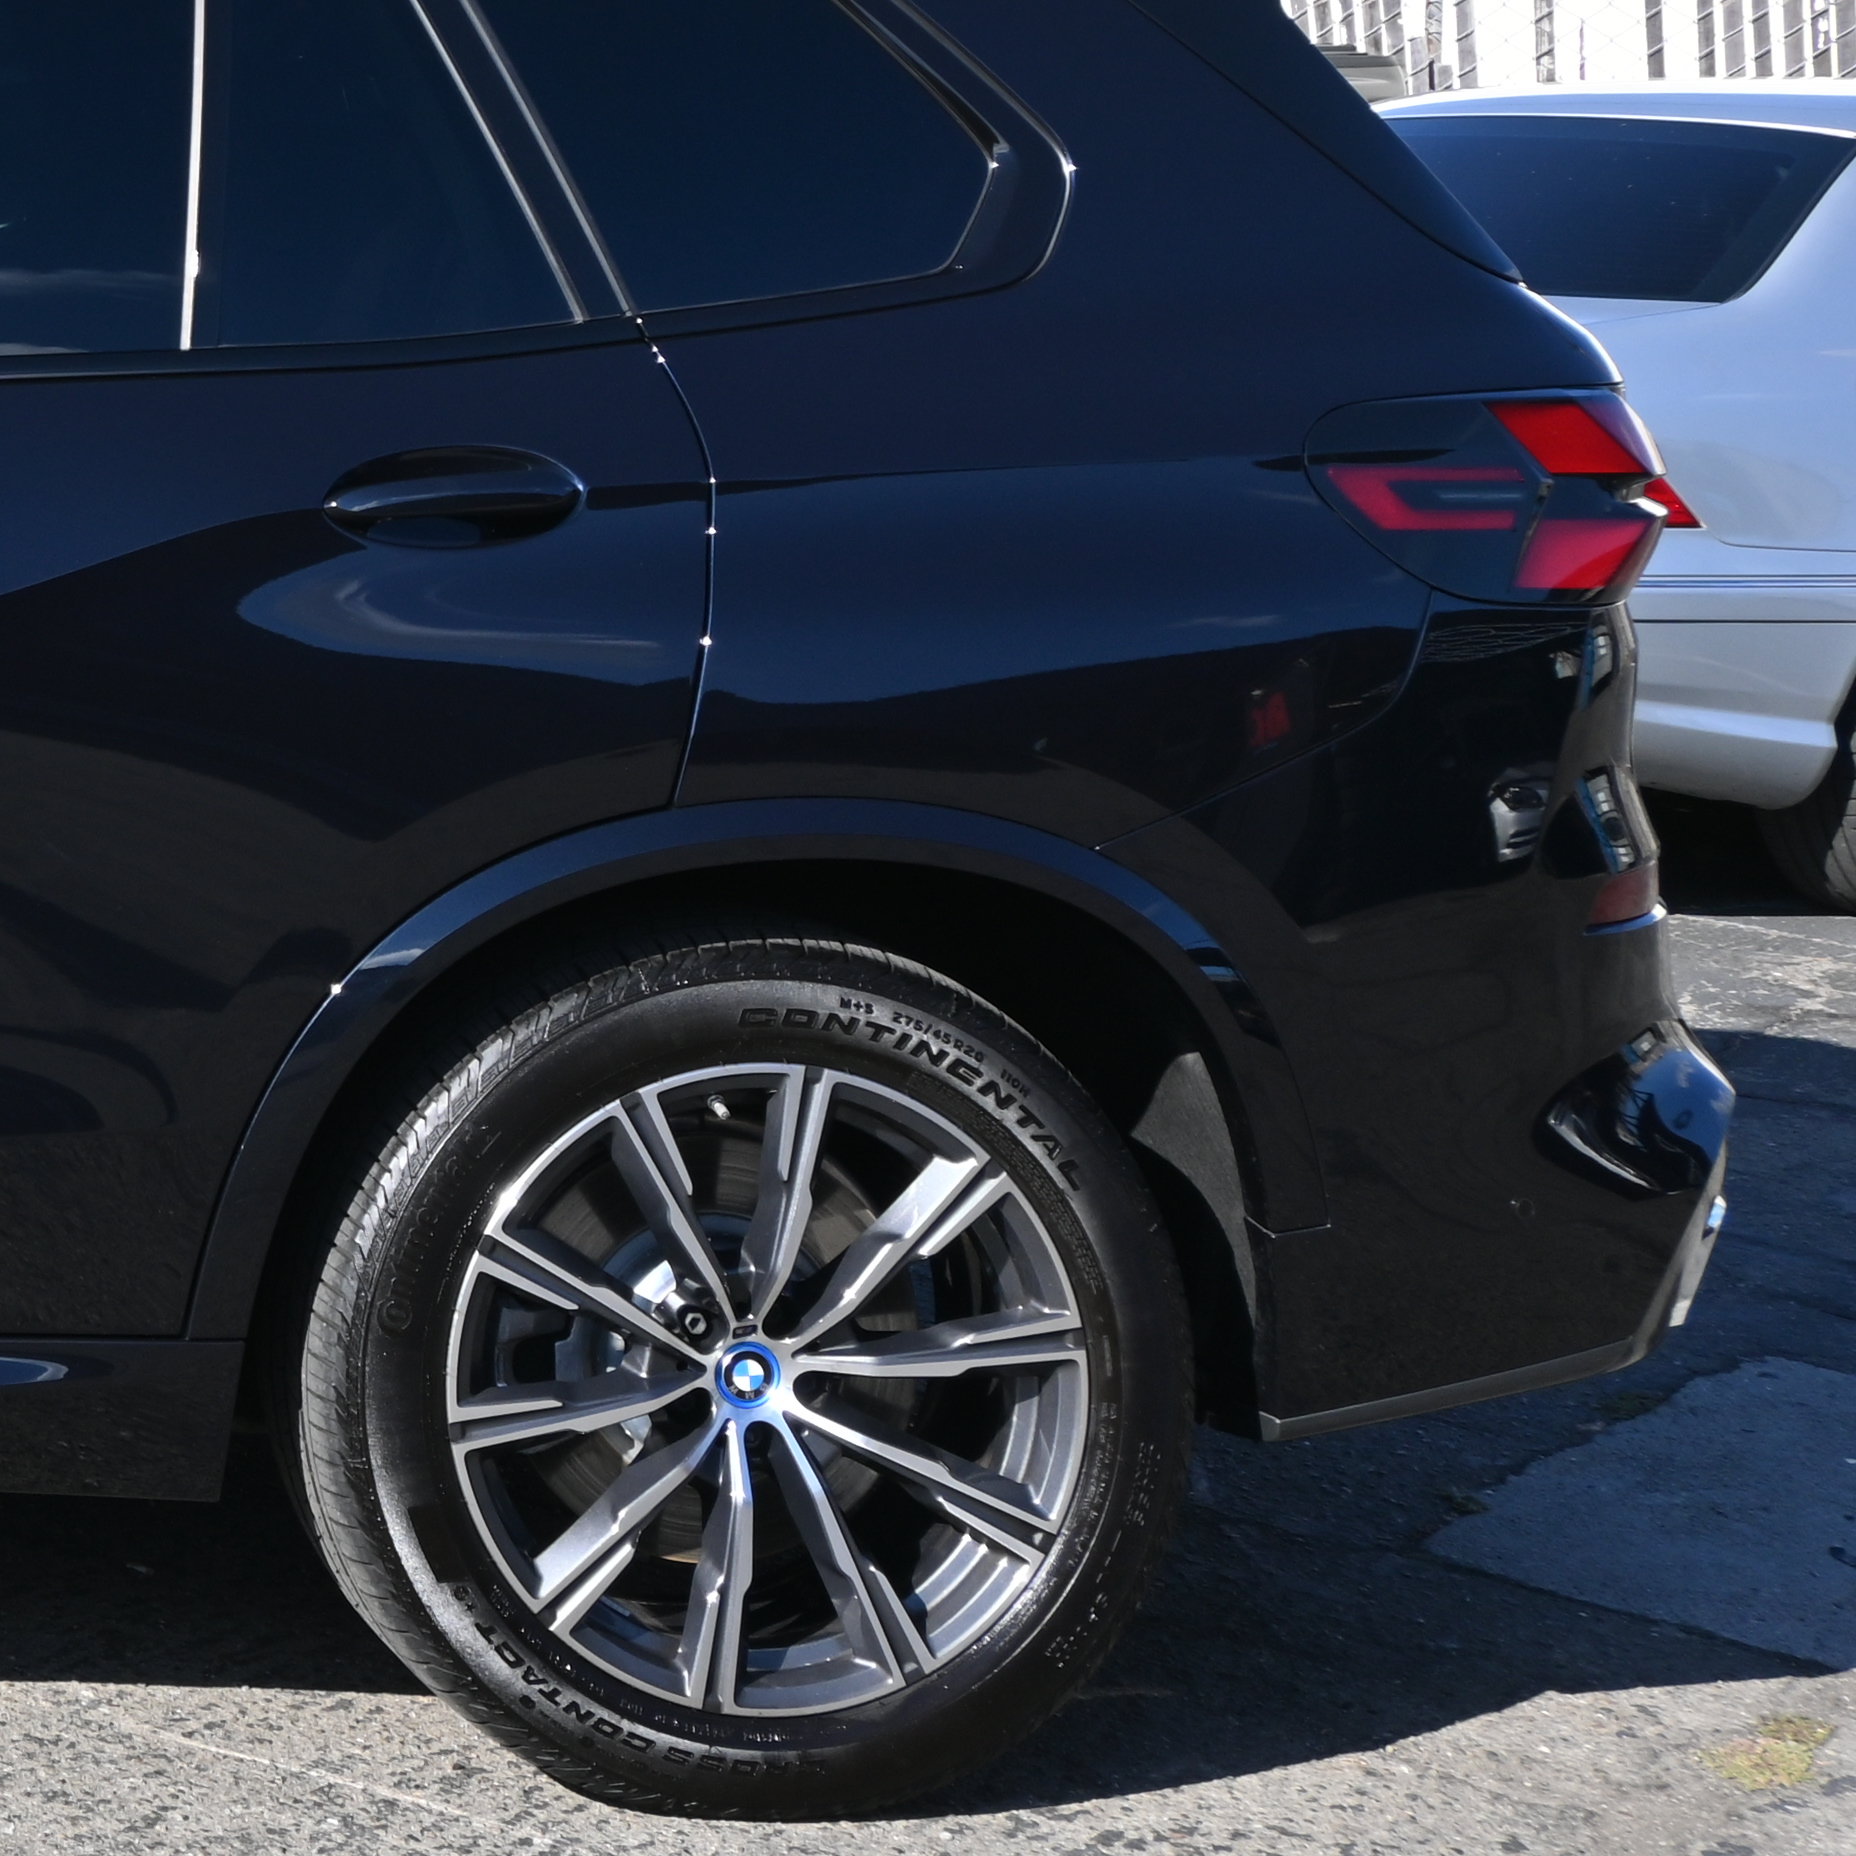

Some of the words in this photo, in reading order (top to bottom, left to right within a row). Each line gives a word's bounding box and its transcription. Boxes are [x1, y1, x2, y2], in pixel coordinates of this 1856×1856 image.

[839, 996, 875, 1016] M+S
[892, 1011, 985, 1063] 275/45R20
[739, 1007, 1081, 1193] CONTINENTAL
[473, 1622, 657, 1754] CONTACT
